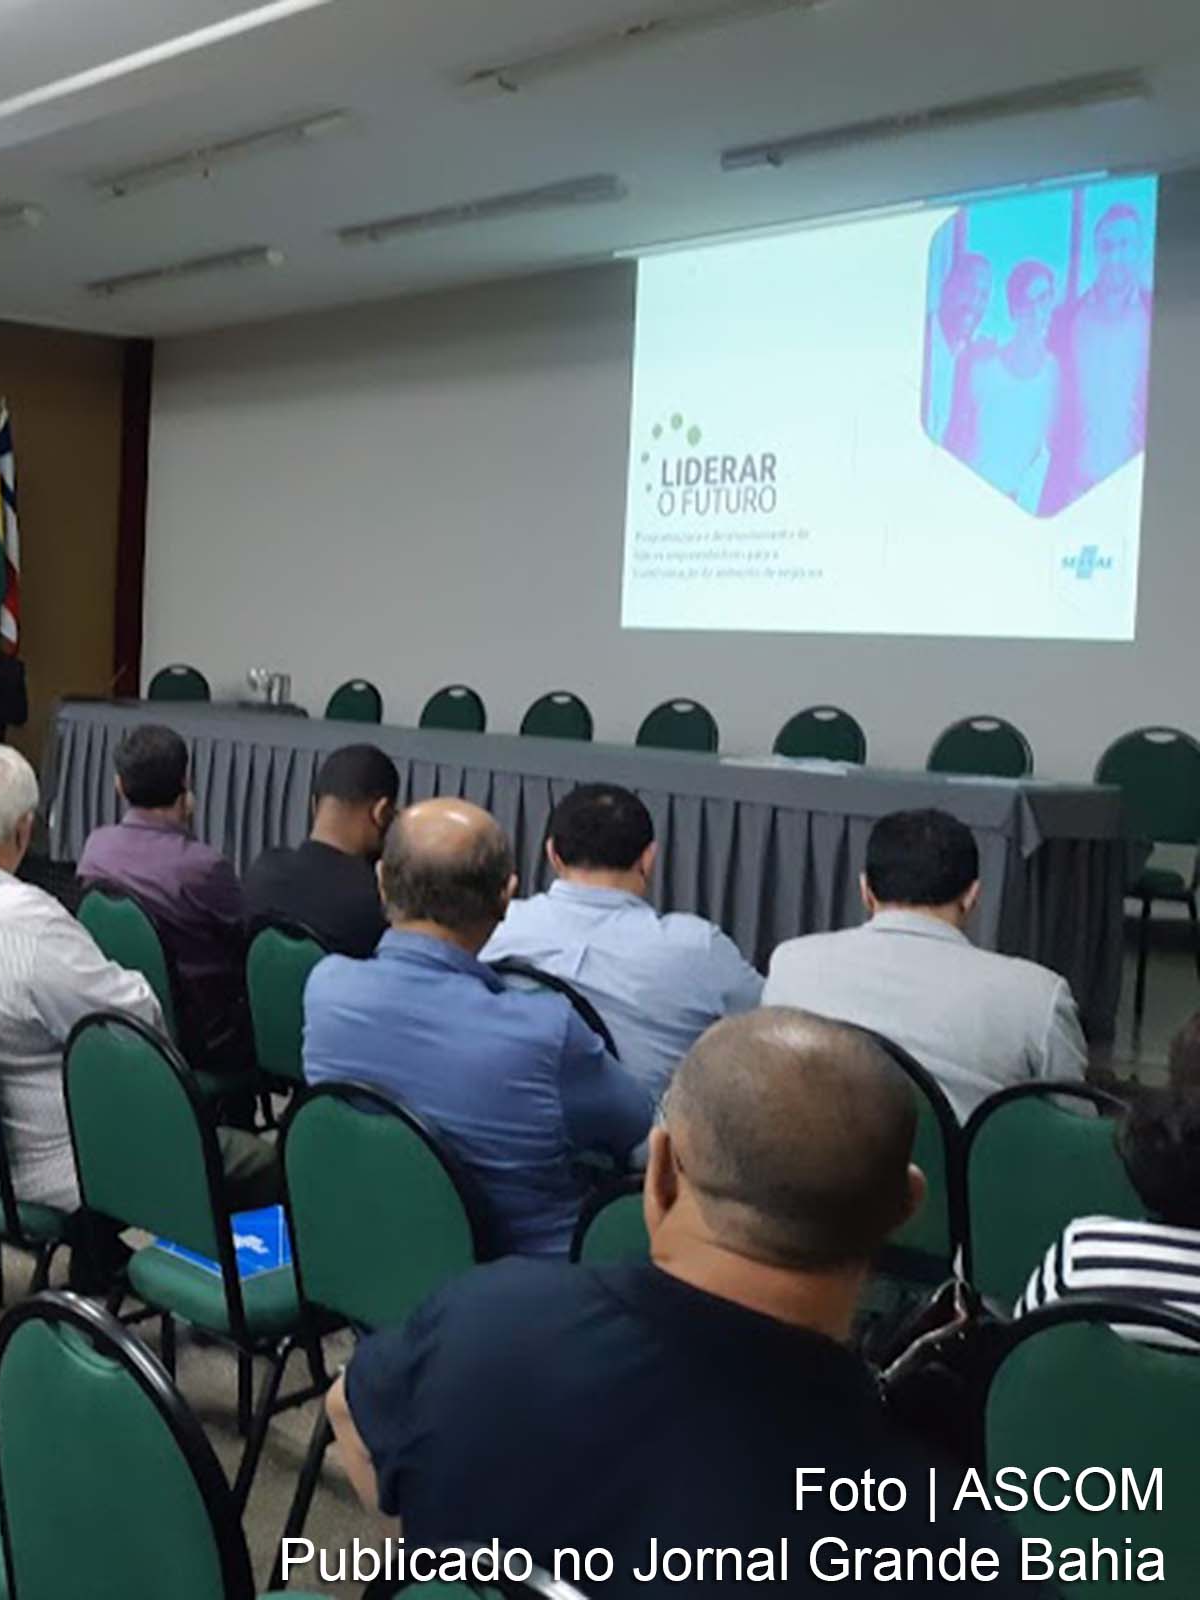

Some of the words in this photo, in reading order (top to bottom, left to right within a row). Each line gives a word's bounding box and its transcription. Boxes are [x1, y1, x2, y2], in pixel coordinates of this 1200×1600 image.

[661, 452, 777, 487] LIDERAR
[658, 489, 675, 516] O
[680, 484, 777, 516] FUTURO
